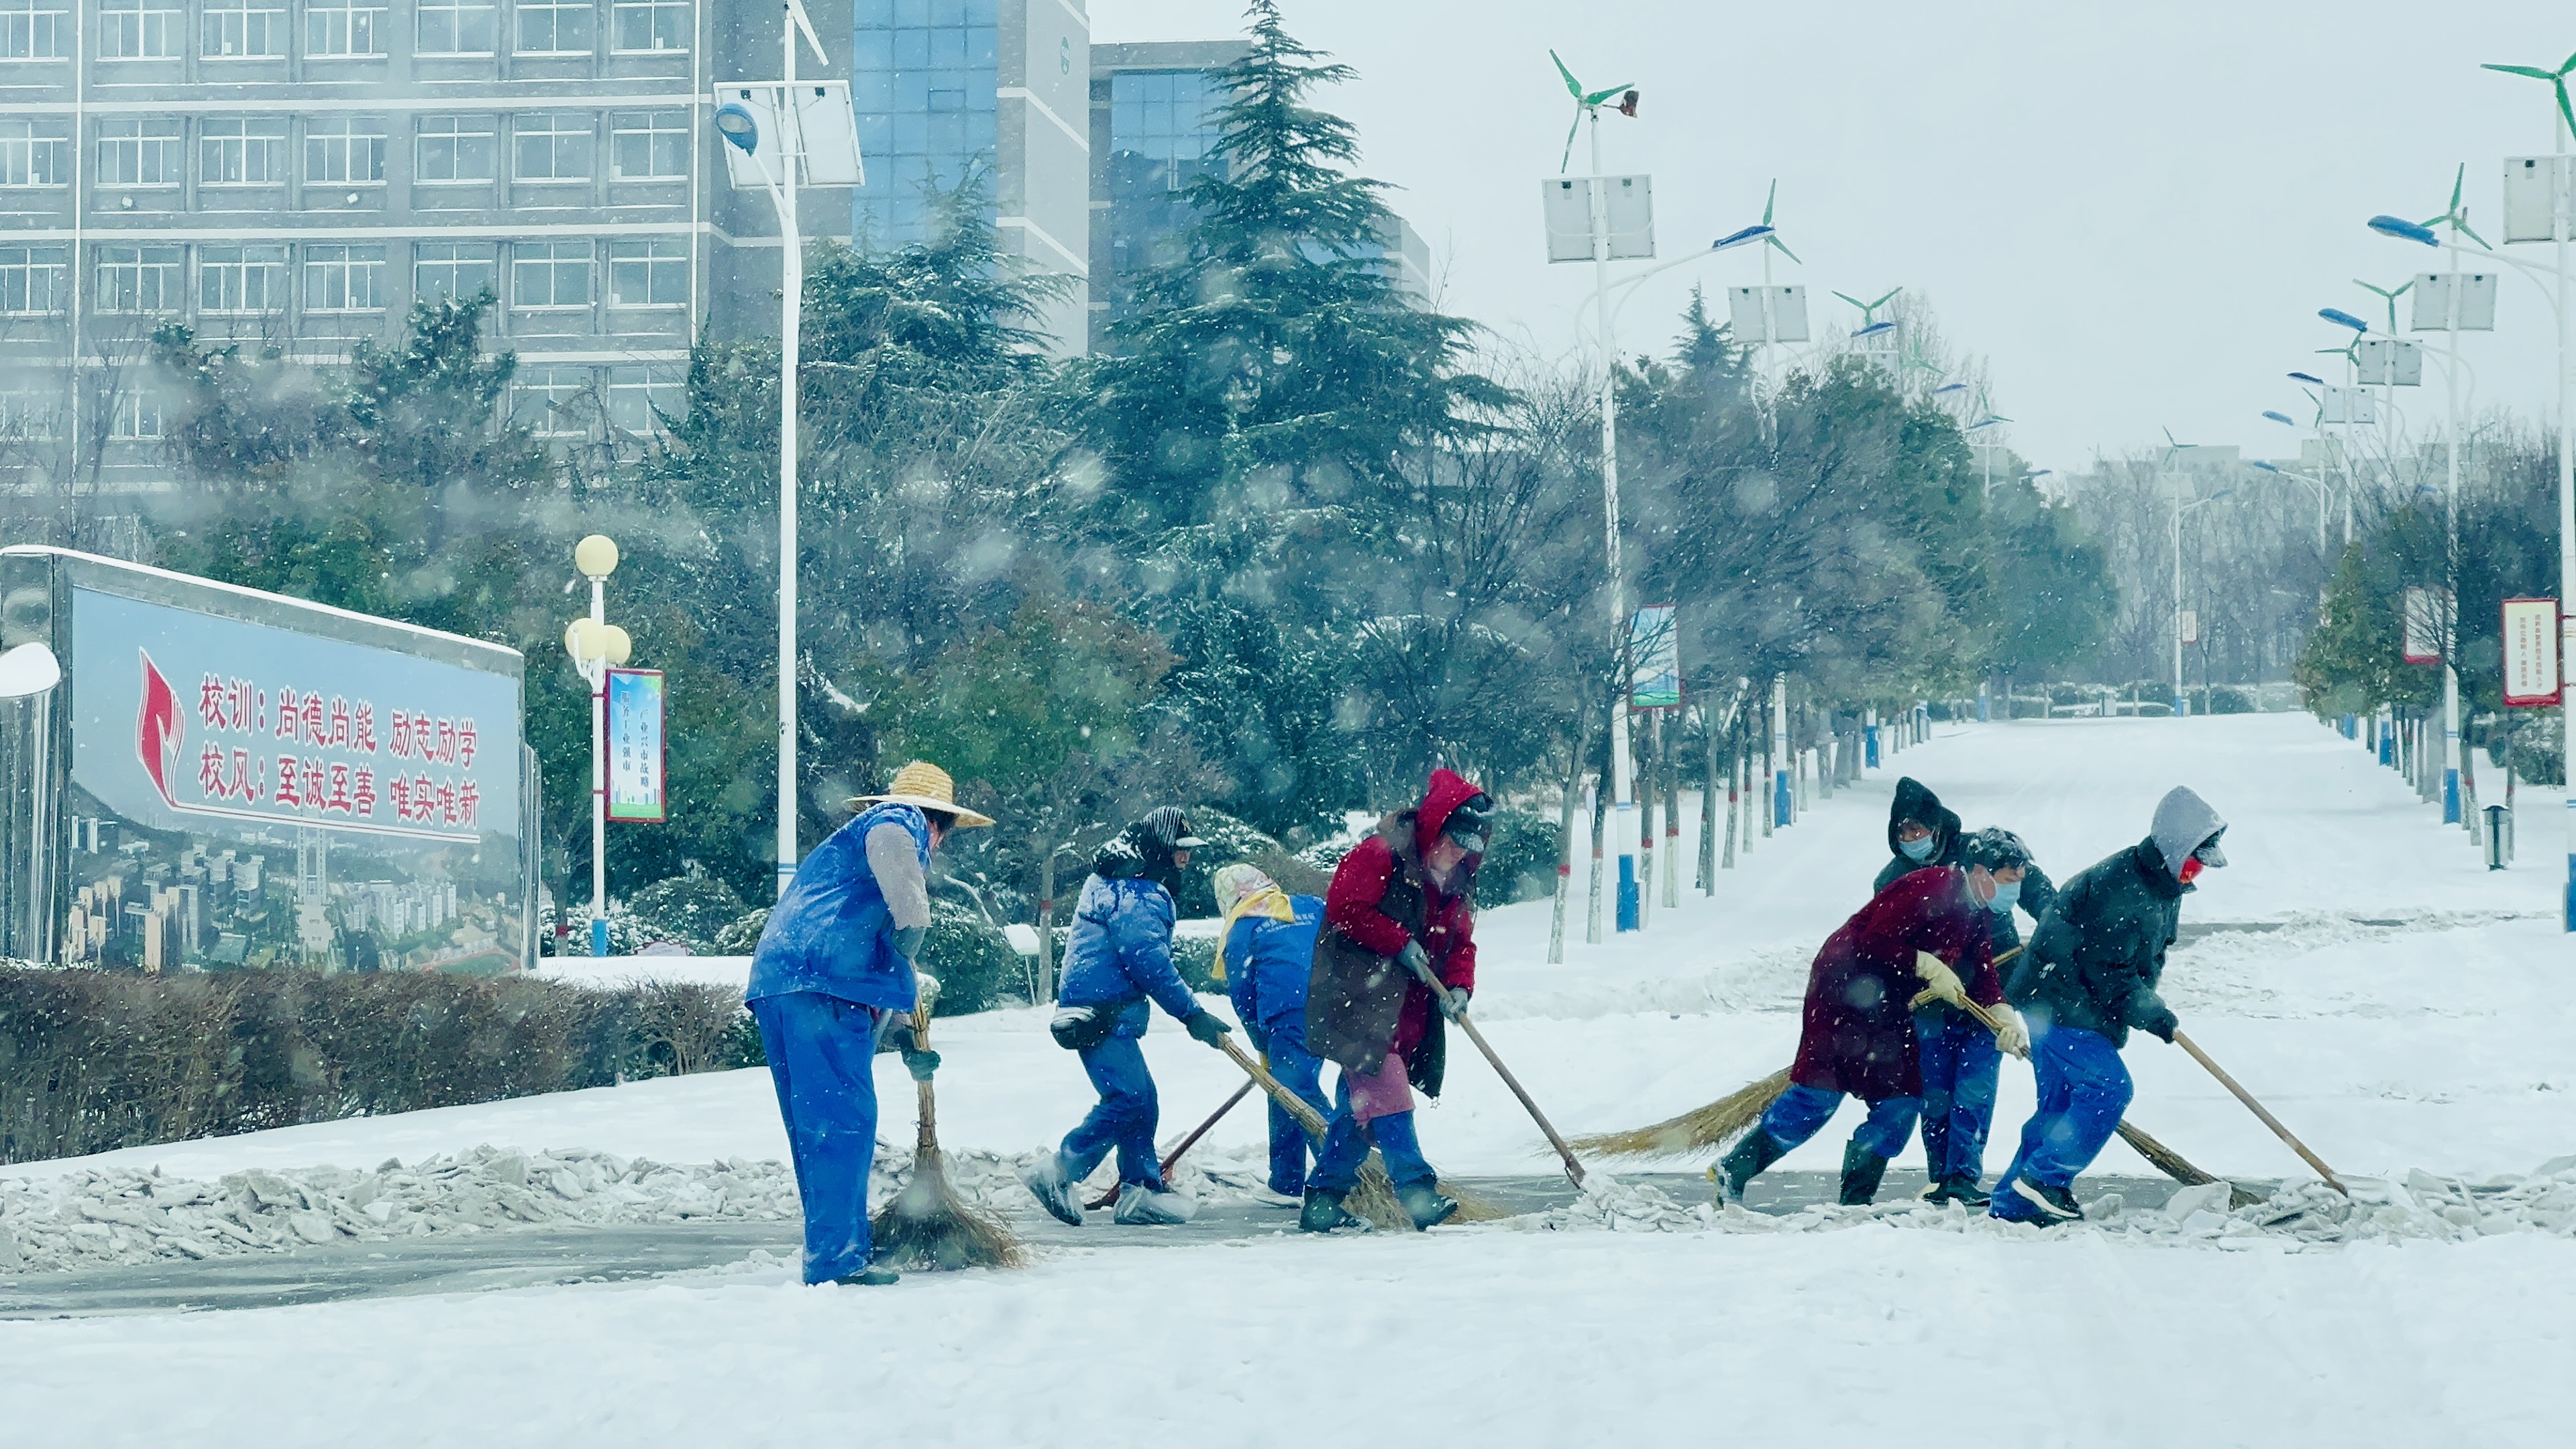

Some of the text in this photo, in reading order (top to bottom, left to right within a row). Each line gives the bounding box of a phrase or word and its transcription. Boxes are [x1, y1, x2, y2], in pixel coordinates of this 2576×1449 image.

[389, 709, 477, 769] 励志励学
[640, 709, 649, 788] 产业兴市战略
[389, 771, 479, 828] 唯实唯新
